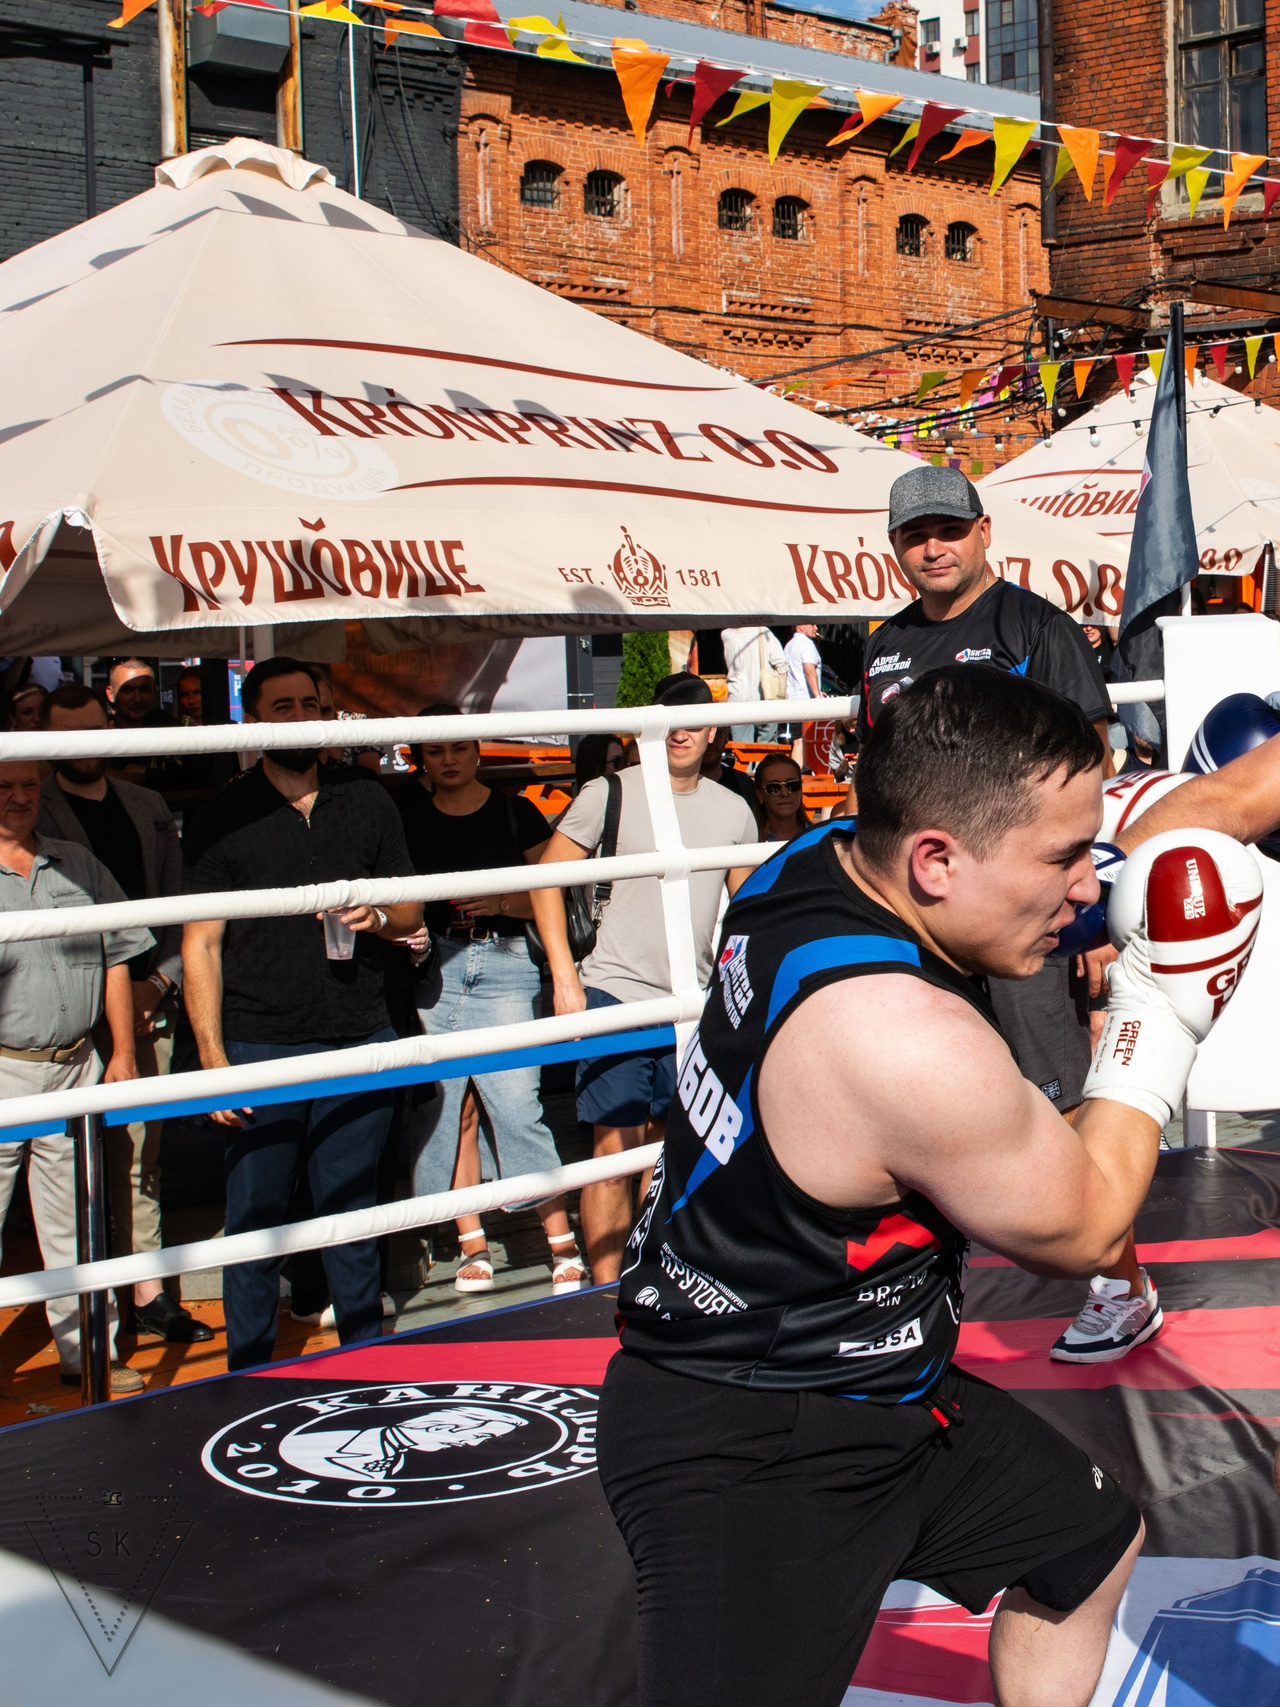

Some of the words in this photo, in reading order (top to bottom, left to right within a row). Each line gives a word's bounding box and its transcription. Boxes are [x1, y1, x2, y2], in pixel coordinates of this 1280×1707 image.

[556, 565, 605, 587] EST.
[675, 568, 721, 588] 1581
[1112, 1021, 1132, 1060] HILL
[1121, 1020, 1142, 1067] GREEN
